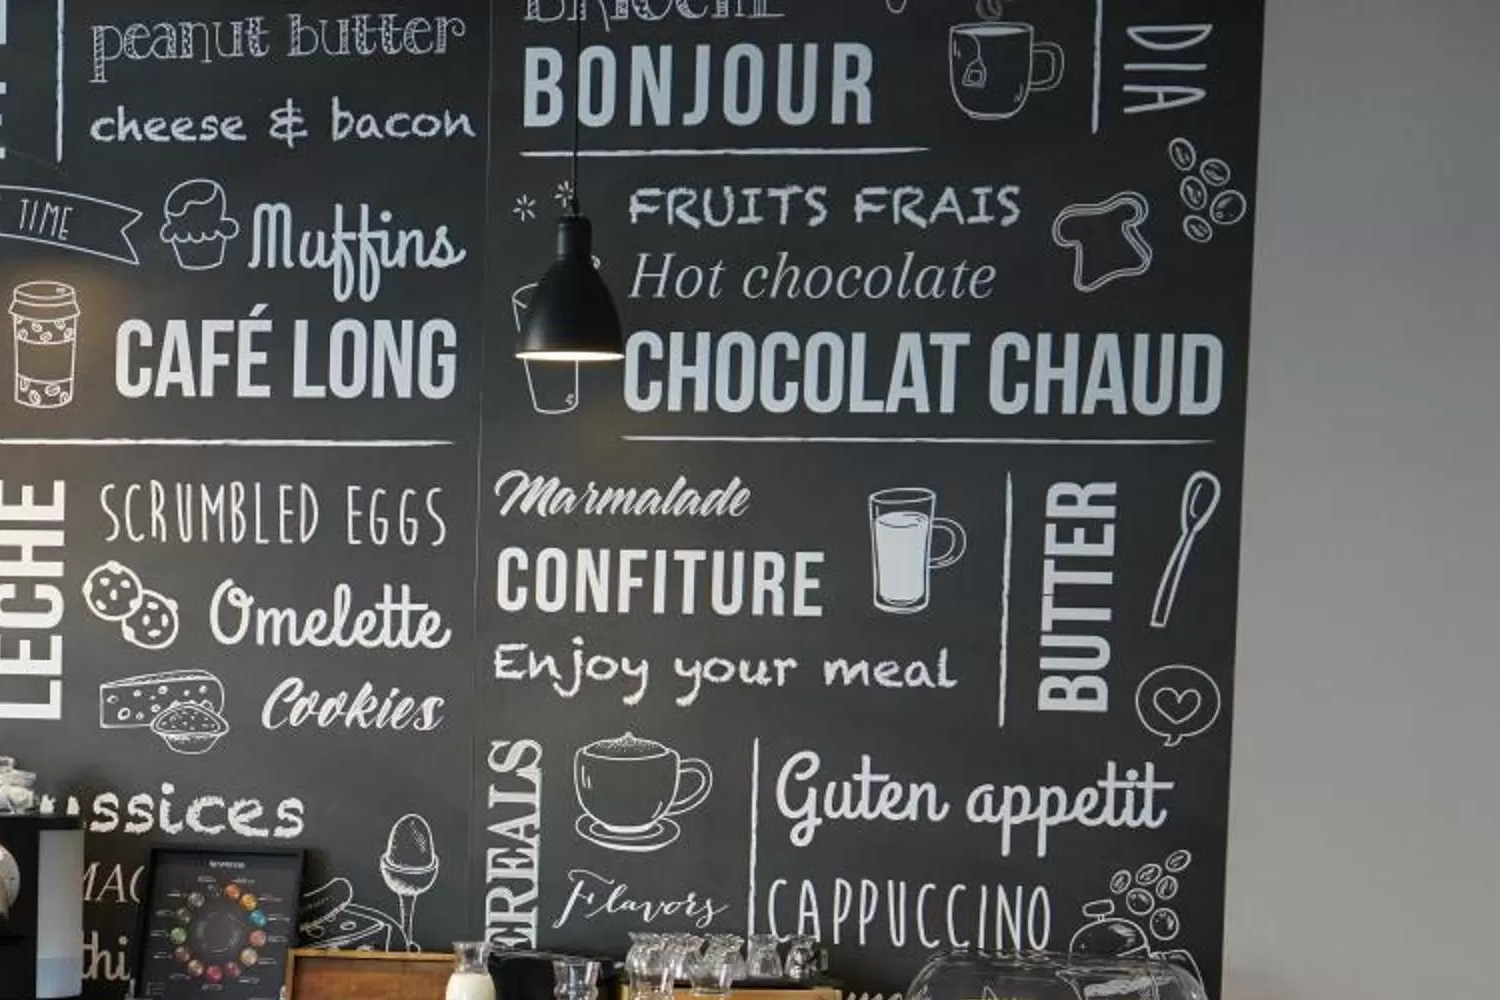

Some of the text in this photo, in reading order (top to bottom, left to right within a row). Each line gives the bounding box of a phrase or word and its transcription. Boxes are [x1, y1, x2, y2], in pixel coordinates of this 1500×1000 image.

[90, 17, 269, 83] peanut
[287, 14, 465, 56] butter
[1123, 24, 1212, 113] DIA
[524, 43, 872, 127] BONJOUR
[90, 96, 475, 148] cheese & bacon
[19, 199, 73, 241] TIME
[629, 185, 1020, 229] FRUITS FRAIS
[248, 203, 466, 302] Muffins
[628, 252, 996, 298] Hot chocolate
[116, 304, 456, 399] CAFÉ LONG
[623, 331, 1222, 415] CHOCOLAT CHAUD
[100, 480, 445, 546] SCRUMBLED EGGS
[494, 470, 750, 517] Marmalade
[210, 578, 451, 648] Omelette
[497, 547, 824, 616] CONFITURE
[1038, 482, 1116, 712] BUTTER
[262, 677, 444, 730] Cookies
[494, 636, 957, 706] Enjoy your meal
[776, 751, 1174, 857] Guten appetit
[484, 739, 542, 950] EREALS
[553, 870, 727, 928] Flavors
[767, 878, 1050, 952] CAPPUCCINO
